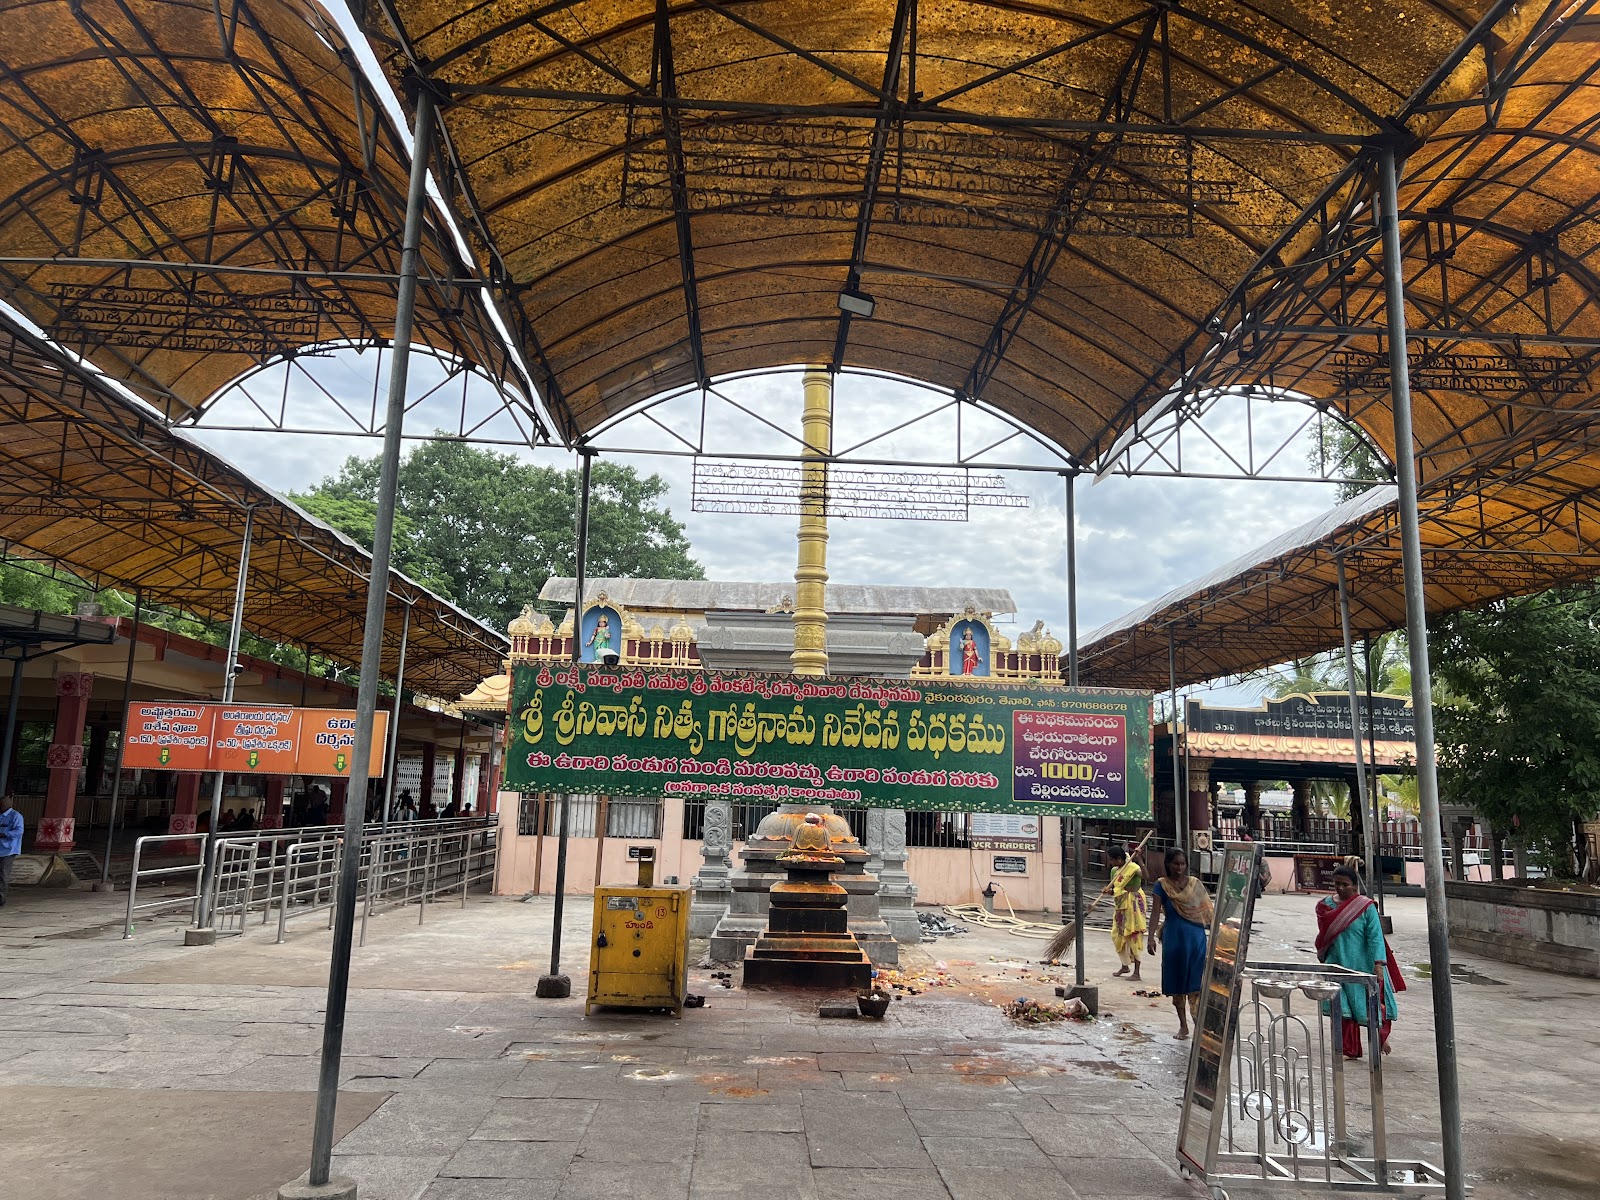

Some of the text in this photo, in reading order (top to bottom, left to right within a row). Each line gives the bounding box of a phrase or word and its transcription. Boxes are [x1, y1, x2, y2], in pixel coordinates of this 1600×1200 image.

[536, 667, 554, 687] శ్రీ
[556, 666, 585, 693] లక్ష్మీ
[587, 670, 645, 693] పద్మావతీ
[647, 672, 688, 691] సమేత
[690, 674, 707, 695] శ్రీ
[710, 676, 846, 701] వేంకటేశ్వరస్వామివారి
[849, 682, 921, 709] దేవస్థానము
[1061, 701, 1128, 712] 9701686678
[520, 688, 543, 744] శ్రీ
[552, 689, 648, 746] శ్రీనివాస
[653, 699, 703, 755] నిత్య
[707, 702, 816, 757] గోత్రనామ
[822, 702, 900, 750] నివేదన
[1018, 713, 1033, 724] ఈ
[172, 723, 198, 734] పూజ
[1022, 729, 1118, 746] ఉభయదాతలుగా
[1029, 746, 1108, 763] చేరగోరువారు
[527, 751, 1000, 789] ఈ ఉగాది పండుగ నుండి మరలవచ్చు ఉగాది పండుగ వరకు
[1014, 762, 1122, 783] రూ. 1000/- లు
[664, 780, 707, 794] (అనగా
[709, 781, 731, 794] ఒక
[732, 783, 788, 800] సంవత్సర
[1030, 783, 1109, 799] చెల్లించవలెను.
[993, 842, 1036, 850] TRADERS
[657, 908, 665, 917] 13
